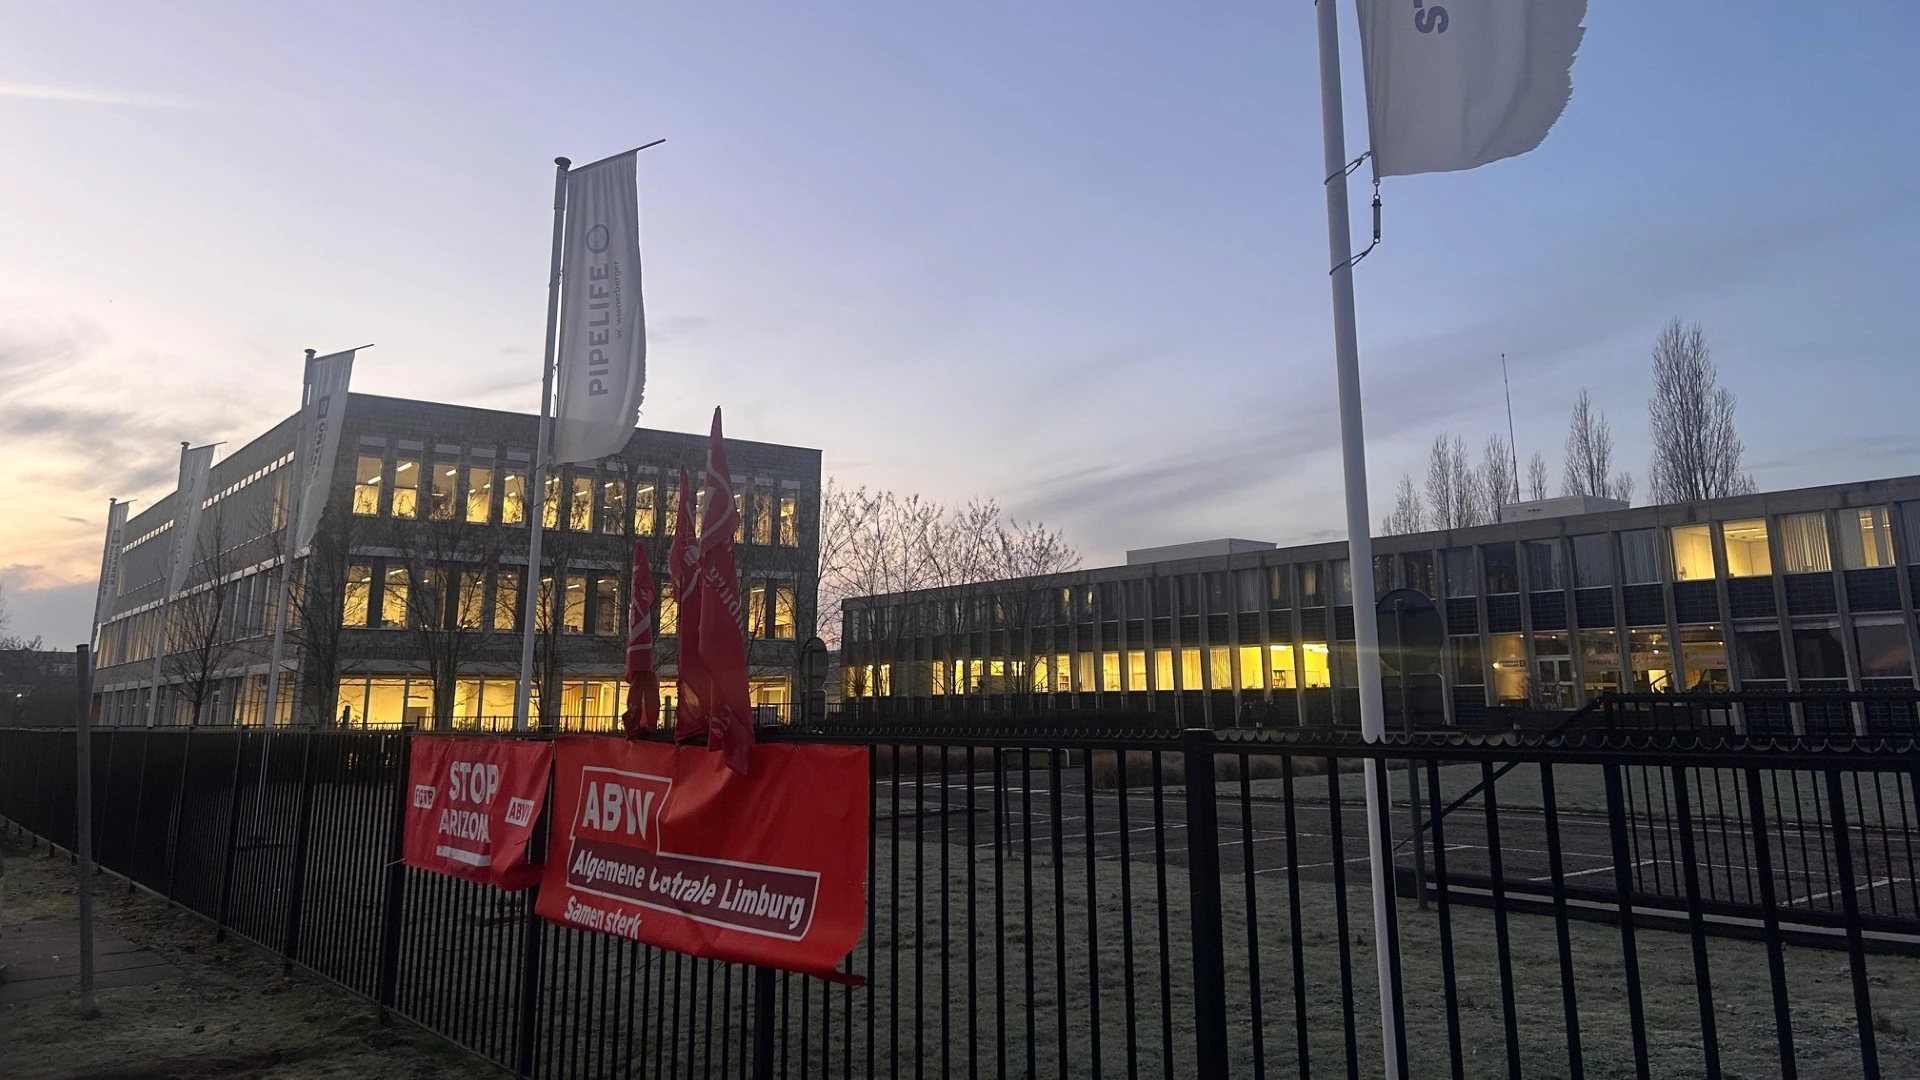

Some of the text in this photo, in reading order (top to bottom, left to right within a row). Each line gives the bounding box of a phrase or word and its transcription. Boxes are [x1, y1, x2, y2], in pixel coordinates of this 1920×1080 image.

[1413, 0, 1449, 34] S
[613, 261, 622, 325] wienerberger
[588, 263, 609, 396] PIPELIFE
[415, 788, 434, 805] FGTB
[449, 760, 499, 805] STOP
[571, 849, 806, 930] Algemene Ctrale Limburg
[563, 895, 642, 941] Samen sterk
